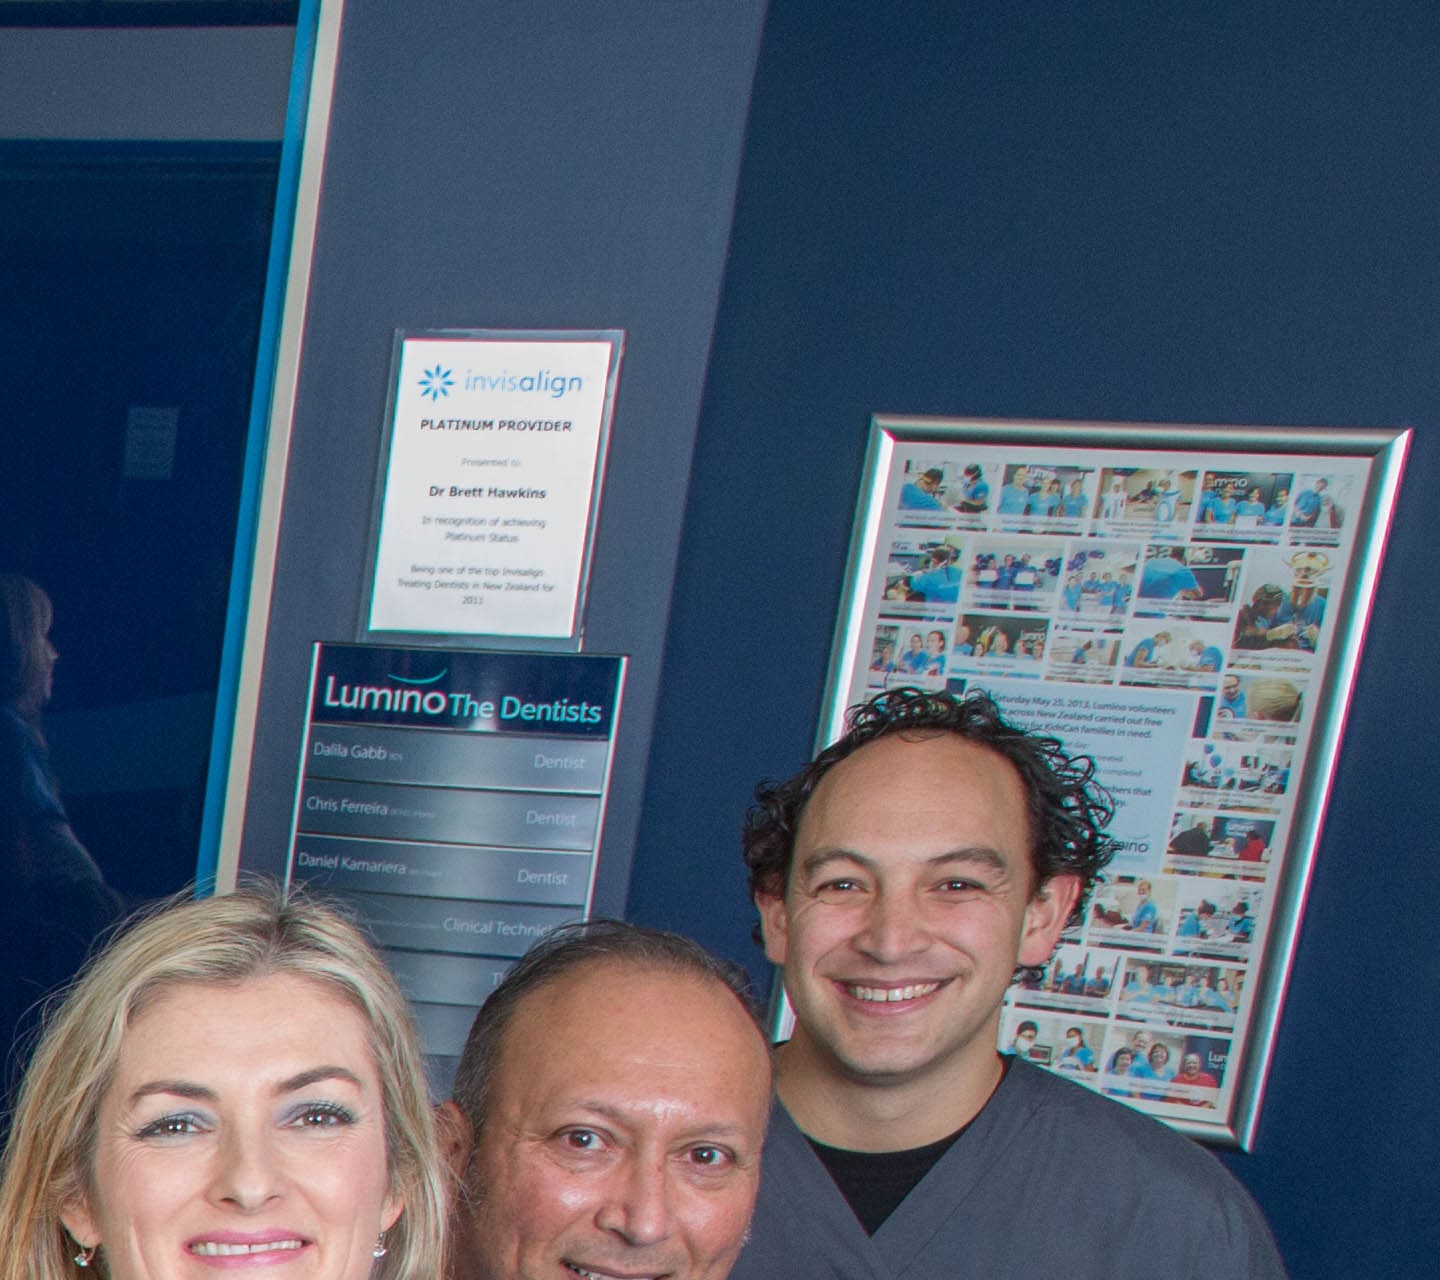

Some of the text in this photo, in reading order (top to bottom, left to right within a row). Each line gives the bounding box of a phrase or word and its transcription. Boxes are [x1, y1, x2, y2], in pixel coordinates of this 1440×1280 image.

[465, 369, 583, 398] invisalign
[420, 419, 572, 432] PLATINUM PROVIDER
[461, 458, 520, 467] Presented to
[429, 486, 547, 499] Dr Brett Hawkins
[435, 516, 486, 527] recognition
[489, 517, 499, 526] of
[502, 517, 546, 528] achieving
[445, 531, 518, 543] Platinum Status
[411, 565, 435, 575] Being
[438, 567, 453, 575] one
[456, 566, 467, 575] of
[468, 566, 482, 575] the
[398, 579, 431, 590] Treating
[434, 580, 468, 590] Dentists
[483, 582, 502, 591] New
[505, 582, 539, 592] Zealand
[324, 675, 602, 723] Lumino The Dentists
[1032, 697, 1050, 707] May
[1092, 702, 1127, 711] Lumino
[1128, 704, 1176, 714] volunteers
[1037, 709, 1056, 718] New
[1058, 711, 1093, 721] Zealand
[1095, 714, 1125, 724] carried
[1127, 716, 1143, 725] out
[1144, 717, 1162, 726] free
[1080, 725, 1115, 736] families
[1117, 728, 1126, 736] in
[1127, 729, 1152, 738] need.
[313, 742, 347, 758] Dalila
[351, 744, 387, 760] Gabb
[533, 754, 586, 769] Dentist
[306, 796, 338, 812] Chris
[340, 799, 388, 816] Ferreira
[526, 810, 577, 826] Dentist
[298, 852, 338, 869] Daniel
[517, 868, 569, 885] Dentist
[443, 917, 493, 934] Clinical
